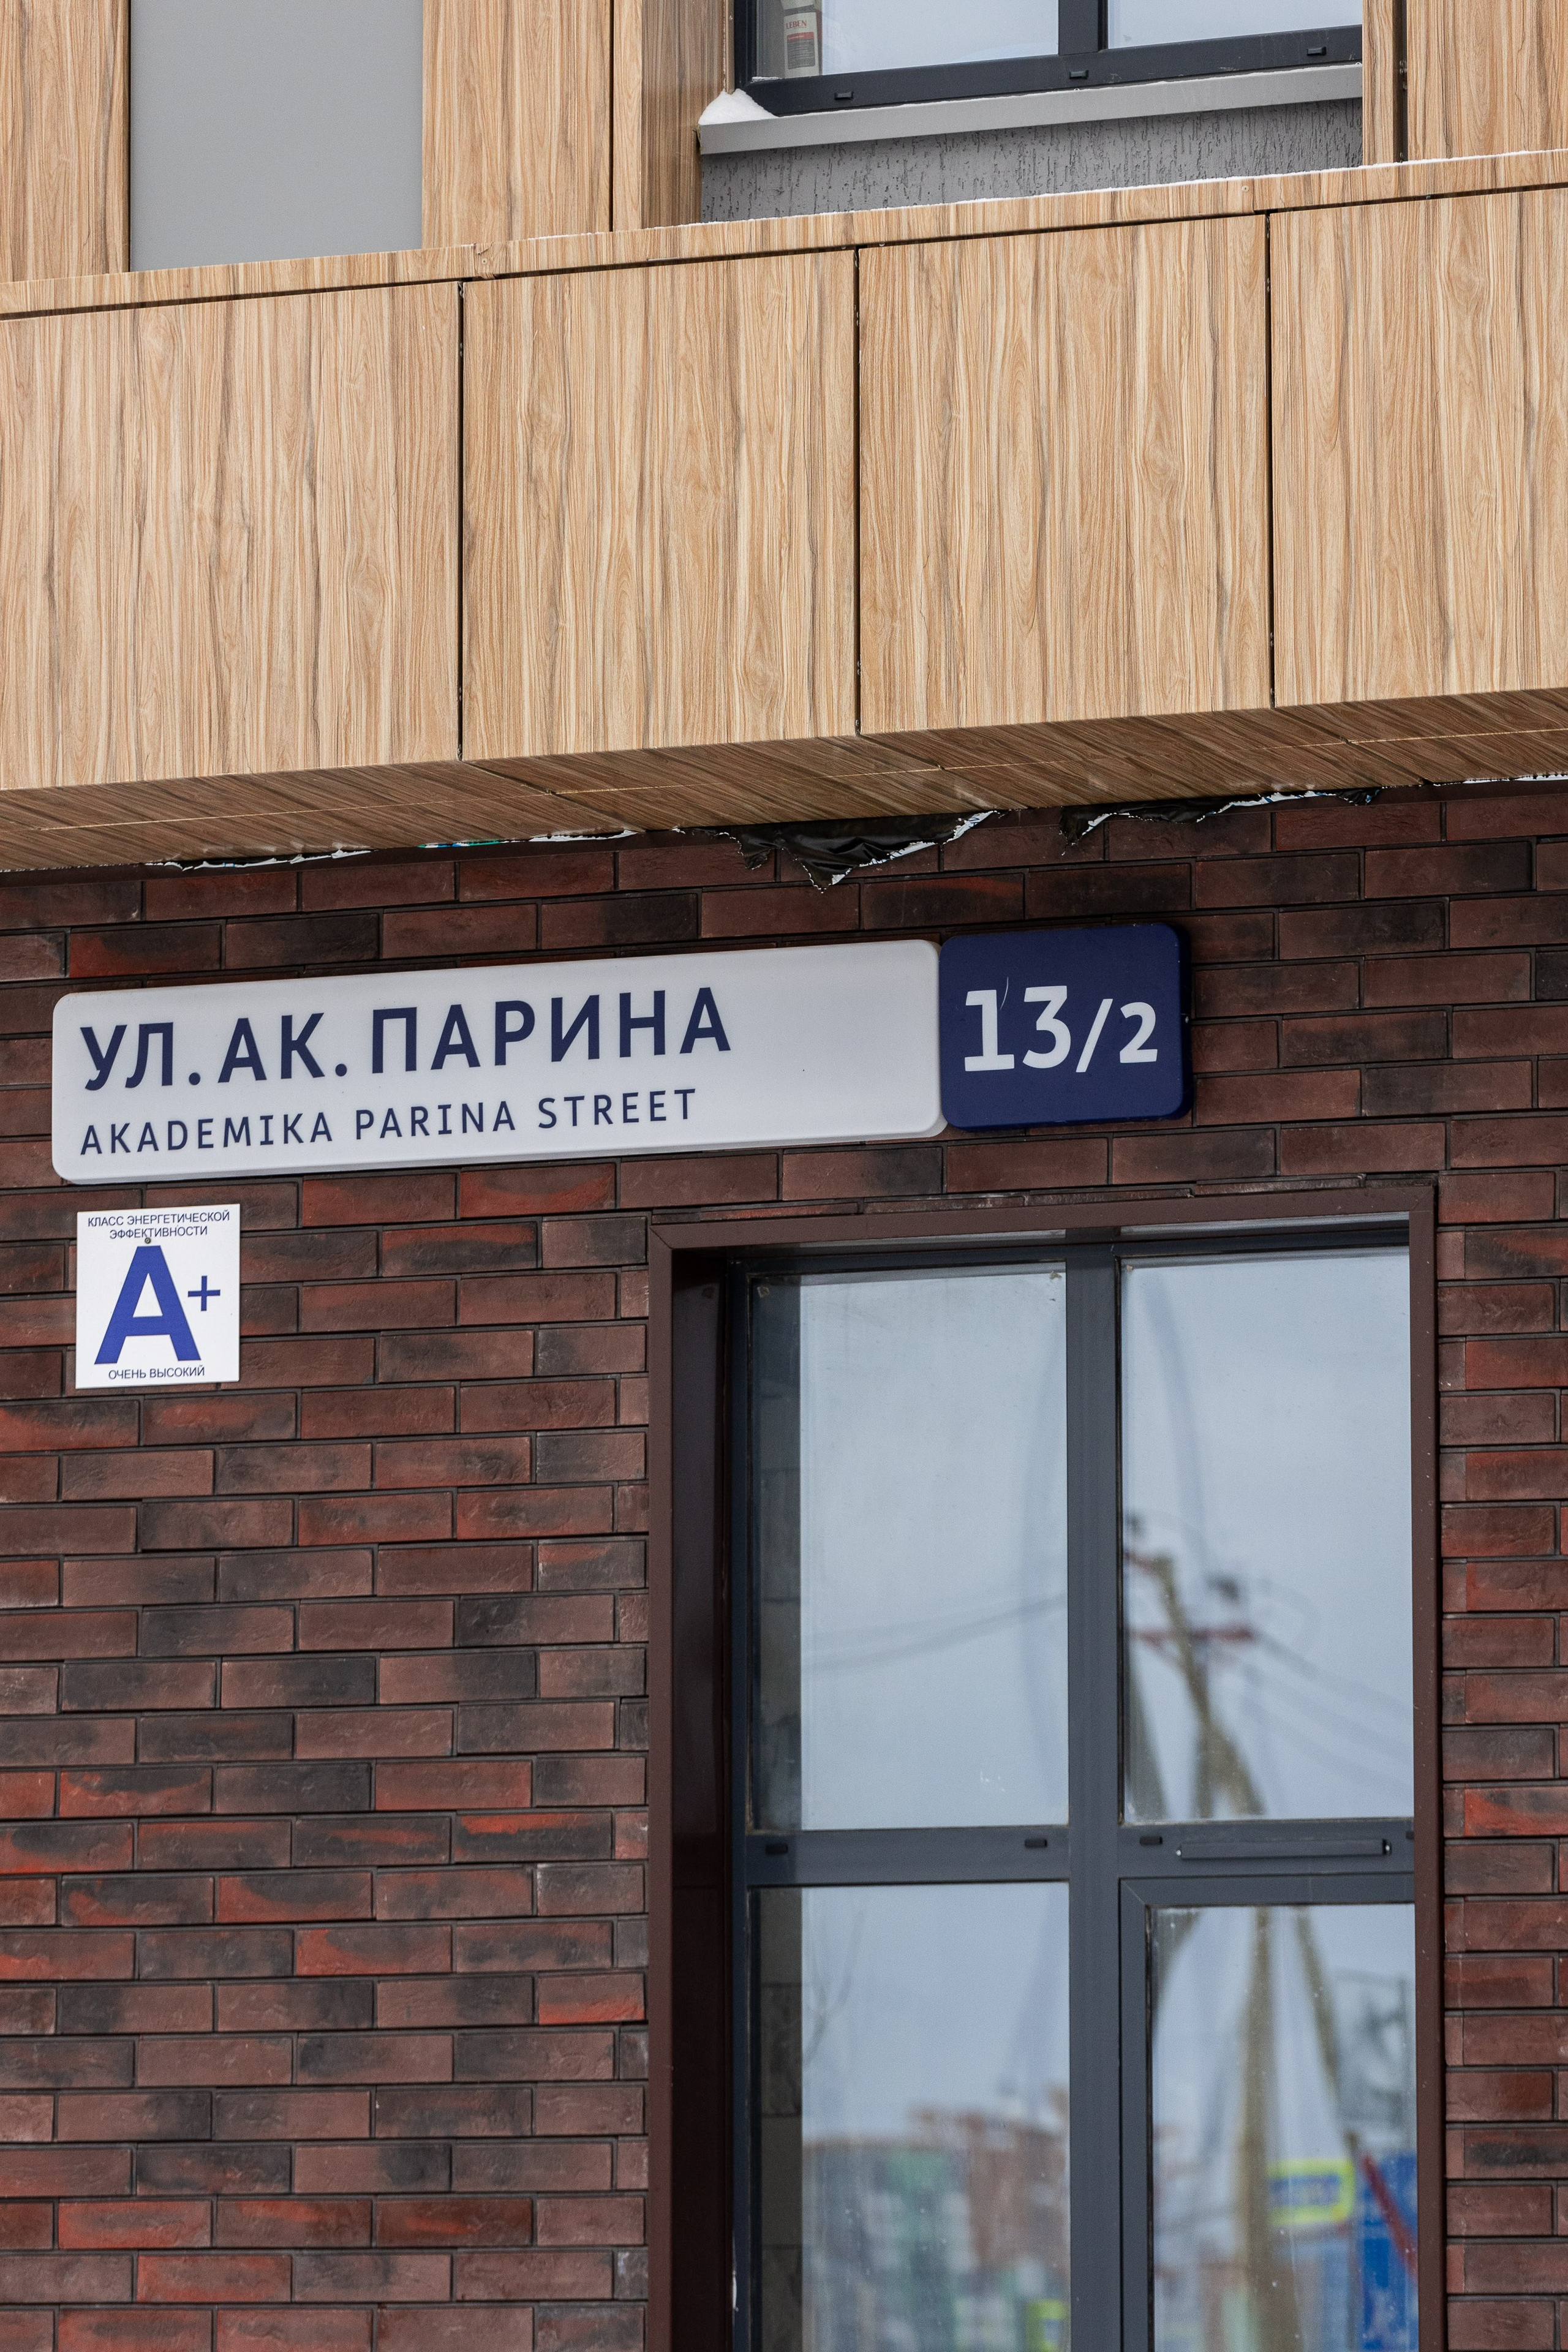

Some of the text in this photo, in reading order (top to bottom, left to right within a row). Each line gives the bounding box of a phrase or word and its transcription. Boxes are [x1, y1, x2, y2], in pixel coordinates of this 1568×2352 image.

[965, 986, 1158, 1072] 13/2
[80, 1089, 696, 1155] AKADEMIKA PARINA STREET
[88, 1210, 230, 1227] КЛАСС ЭНЕРГЕТИЧЕСКОЙ
[110, 1226, 208, 1240] ЭФФЕКТИВНОСТИ
[108, 1365, 205, 1379] ОЧЕНЬ ВЫСОКИЙ
